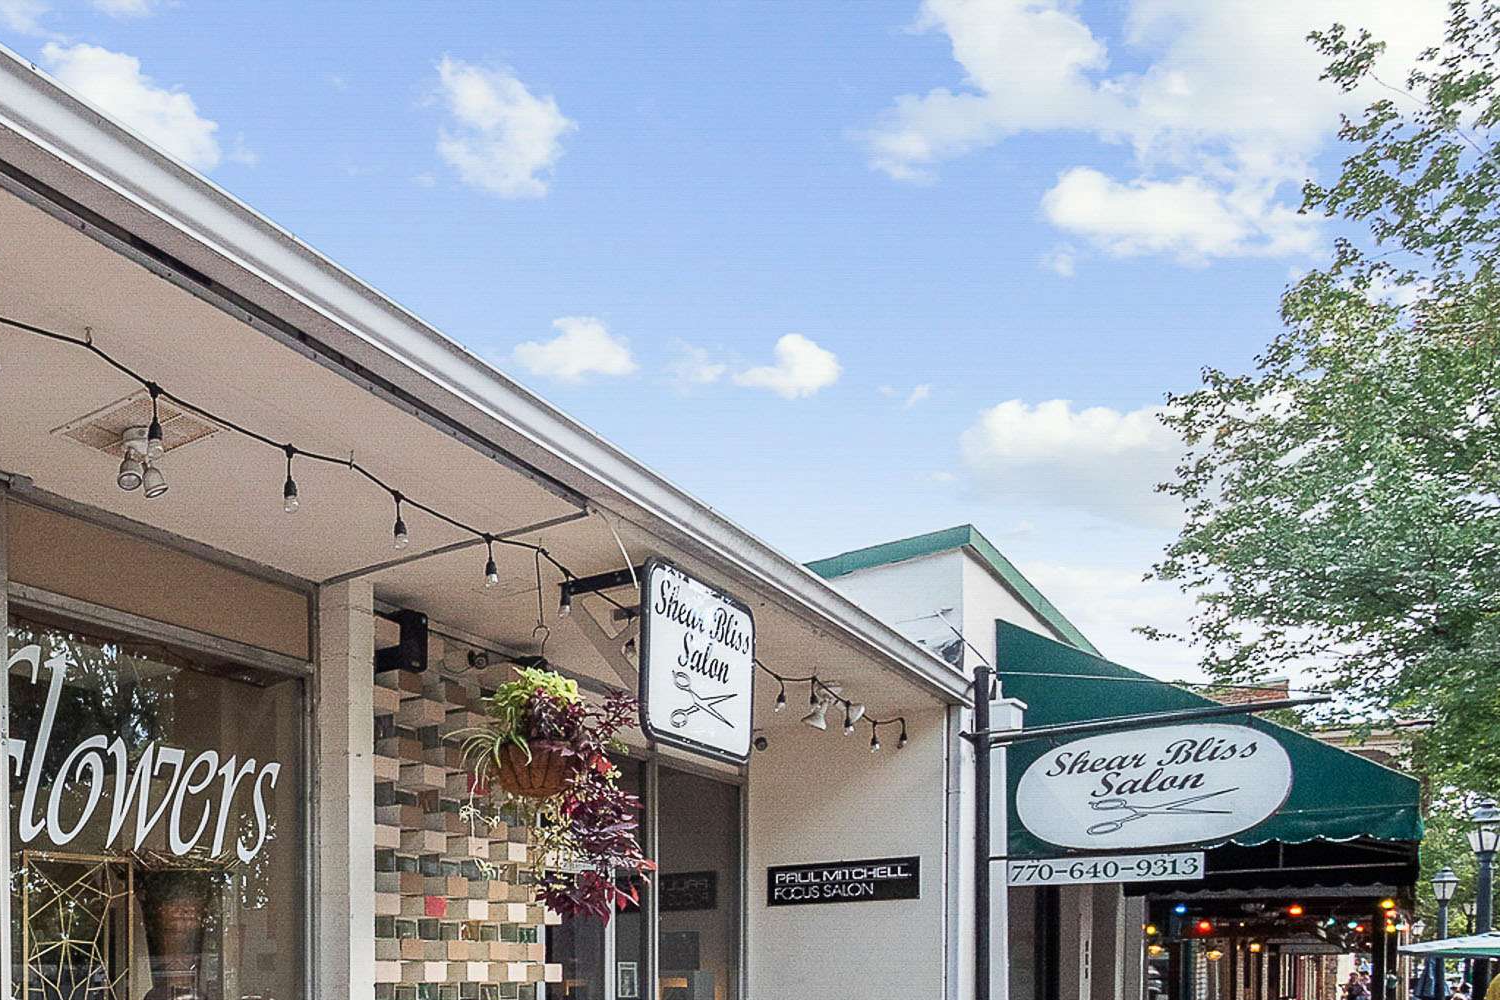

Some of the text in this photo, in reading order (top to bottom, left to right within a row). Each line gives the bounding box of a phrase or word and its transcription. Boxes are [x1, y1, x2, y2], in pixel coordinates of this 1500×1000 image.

[655, 580, 749, 655] Shear Bliss
[678, 631, 729, 684] Salon
[1045, 737, 1259, 777] Shear Bliss
[1090, 768, 1205, 798] Salon
[775, 872, 820, 884] PAUL
[1011, 857, 1198, 882] 770-640-9313
[774, 882, 874, 900] FOCUS SALON
